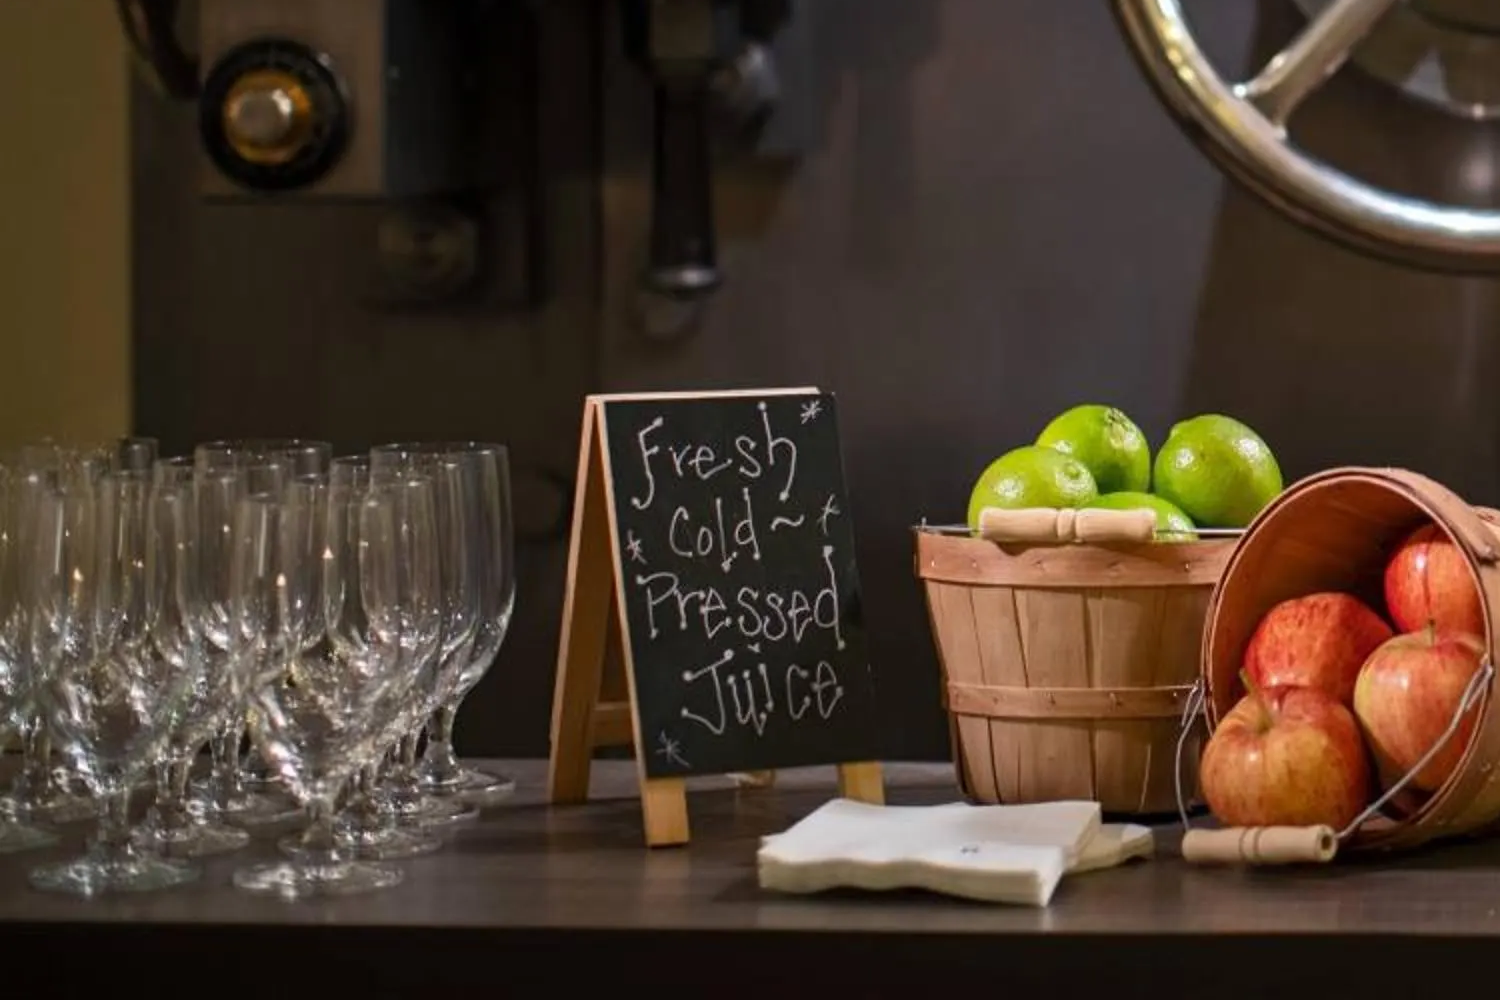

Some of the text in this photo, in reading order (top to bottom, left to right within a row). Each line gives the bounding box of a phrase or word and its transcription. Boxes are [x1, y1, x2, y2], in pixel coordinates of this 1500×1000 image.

[632, 402, 798, 510] Fresh
[636, 546, 846, 650] Pressed
[680, 643, 844, 735] Juice
